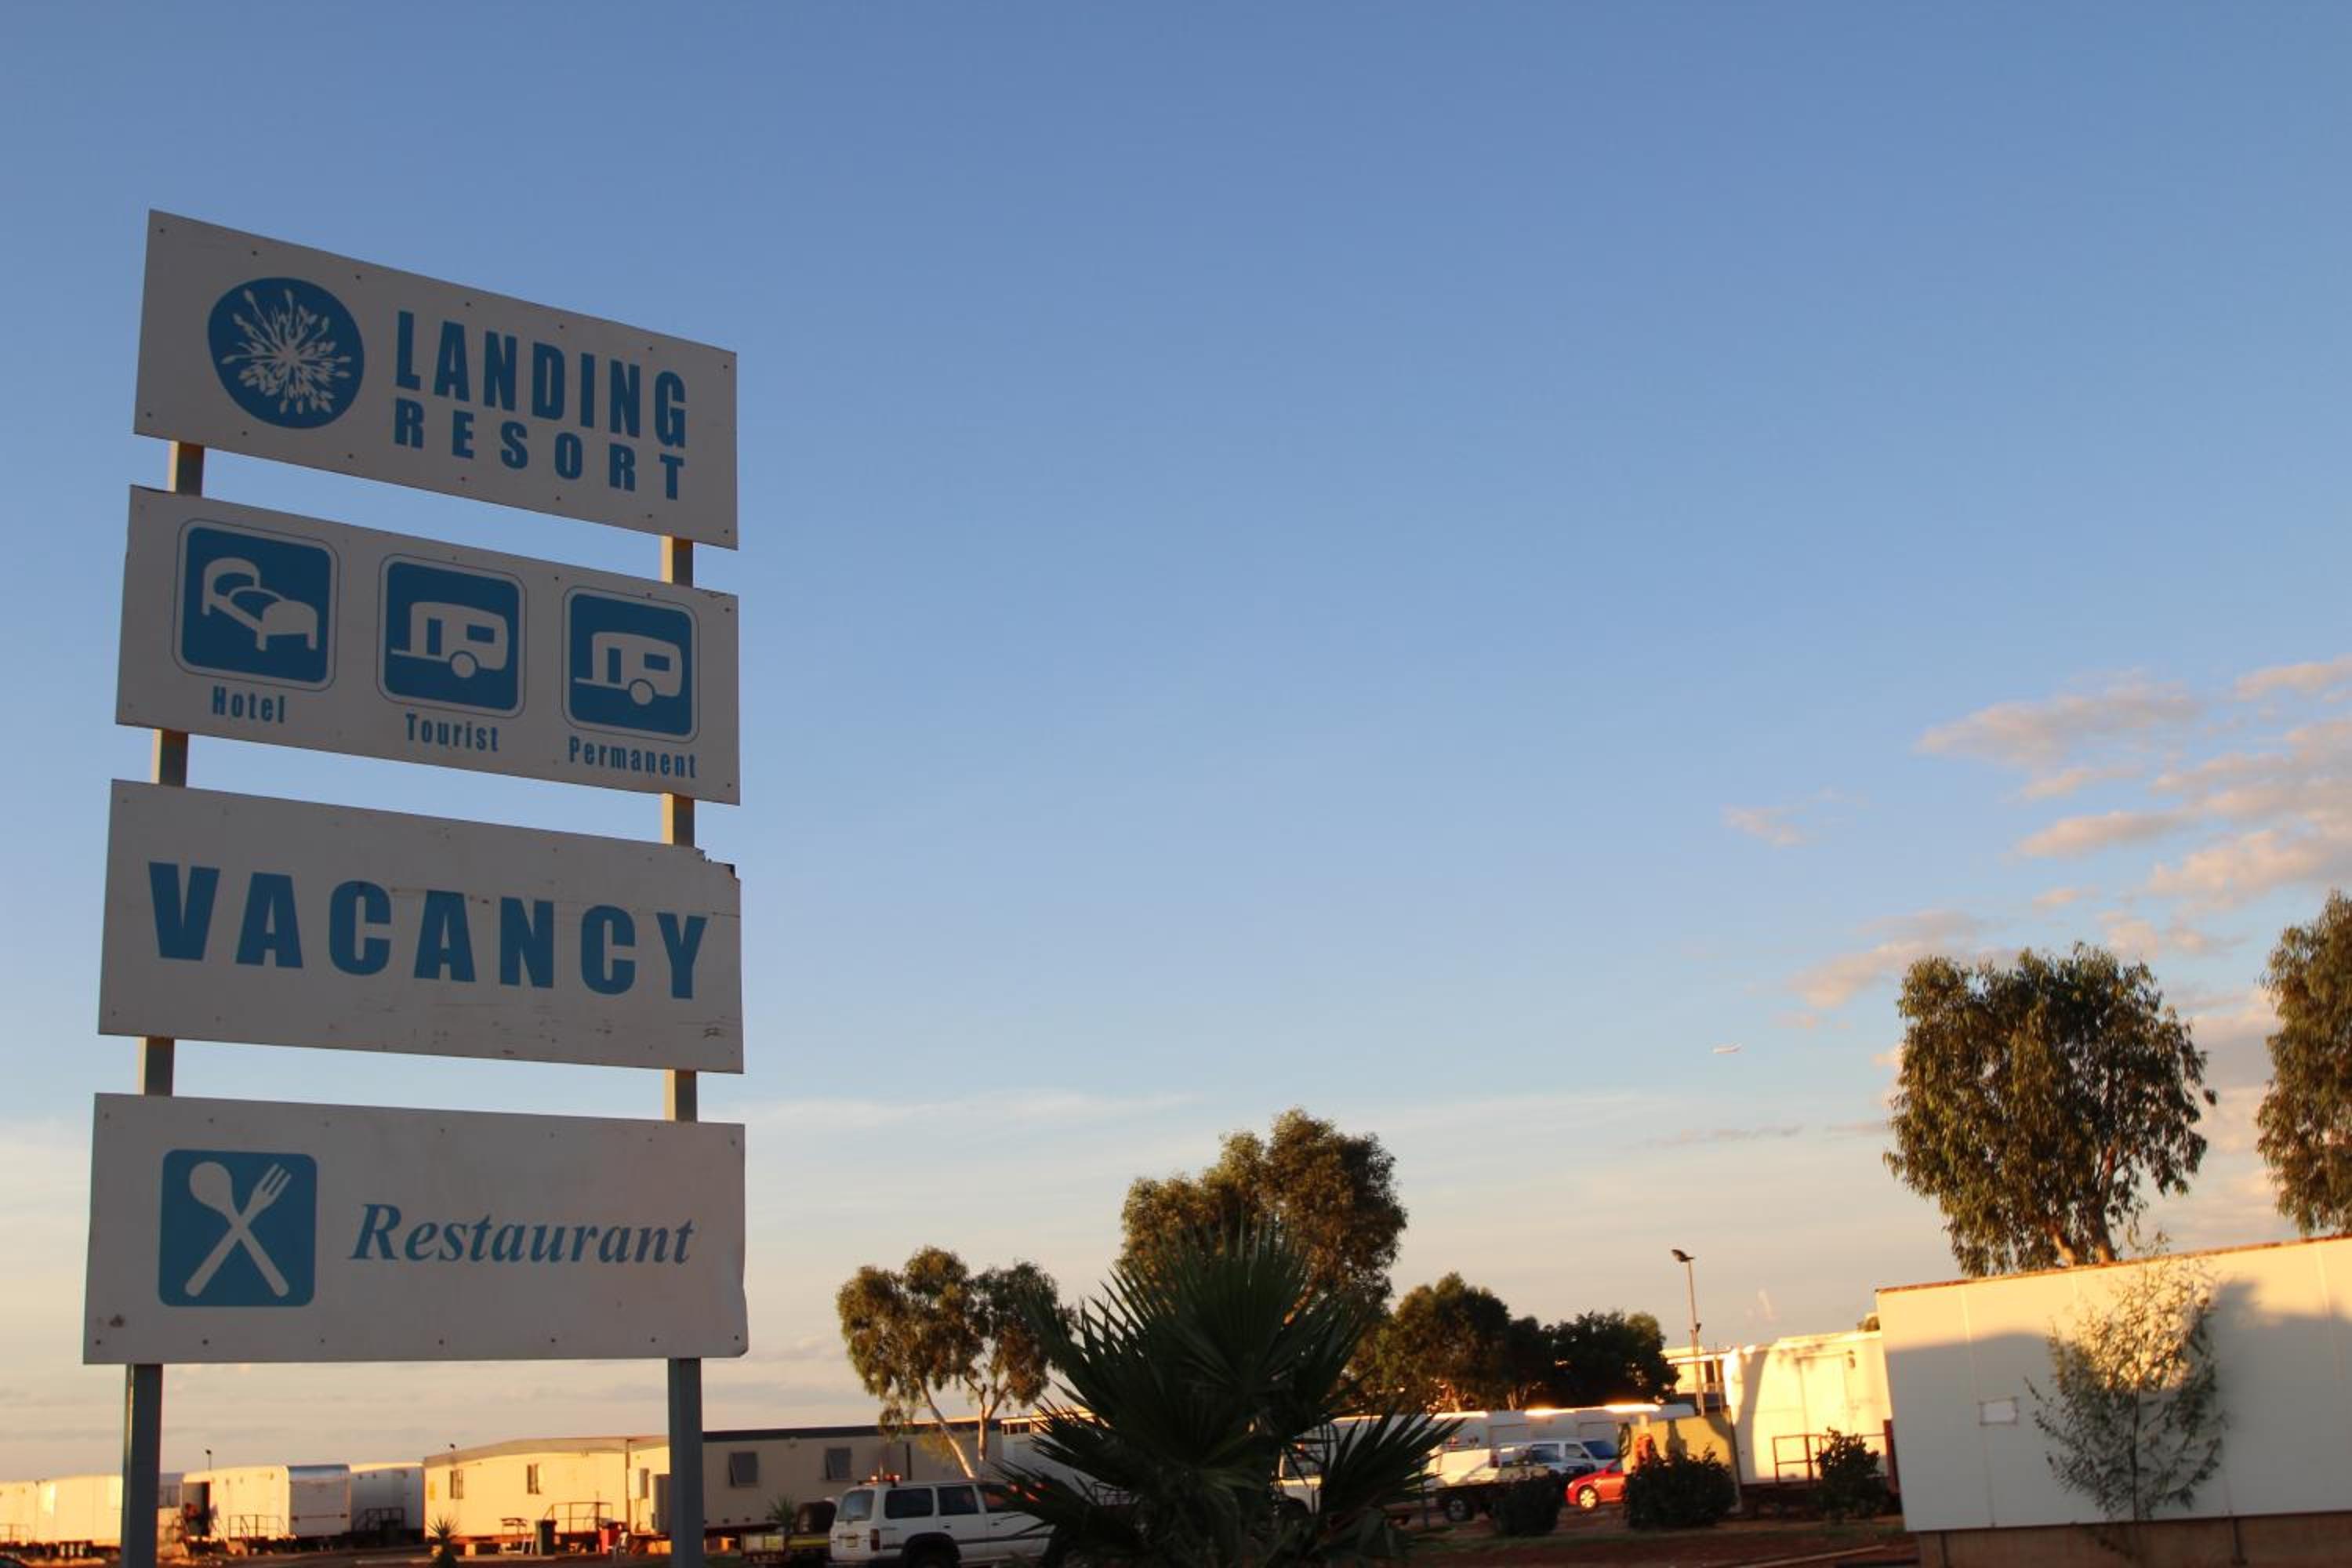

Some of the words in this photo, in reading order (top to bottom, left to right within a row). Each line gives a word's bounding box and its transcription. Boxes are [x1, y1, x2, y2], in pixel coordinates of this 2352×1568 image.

[395, 310, 687, 448] LANDING
[394, 397, 685, 501] RESORT
[212, 686, 285, 724] Hotel
[405, 712, 500, 753] Tourist
[568, 735, 697, 779] Permanent
[148, 861, 707, 1000] VACANCY
[349, 1203, 694, 1265] Restaurant
